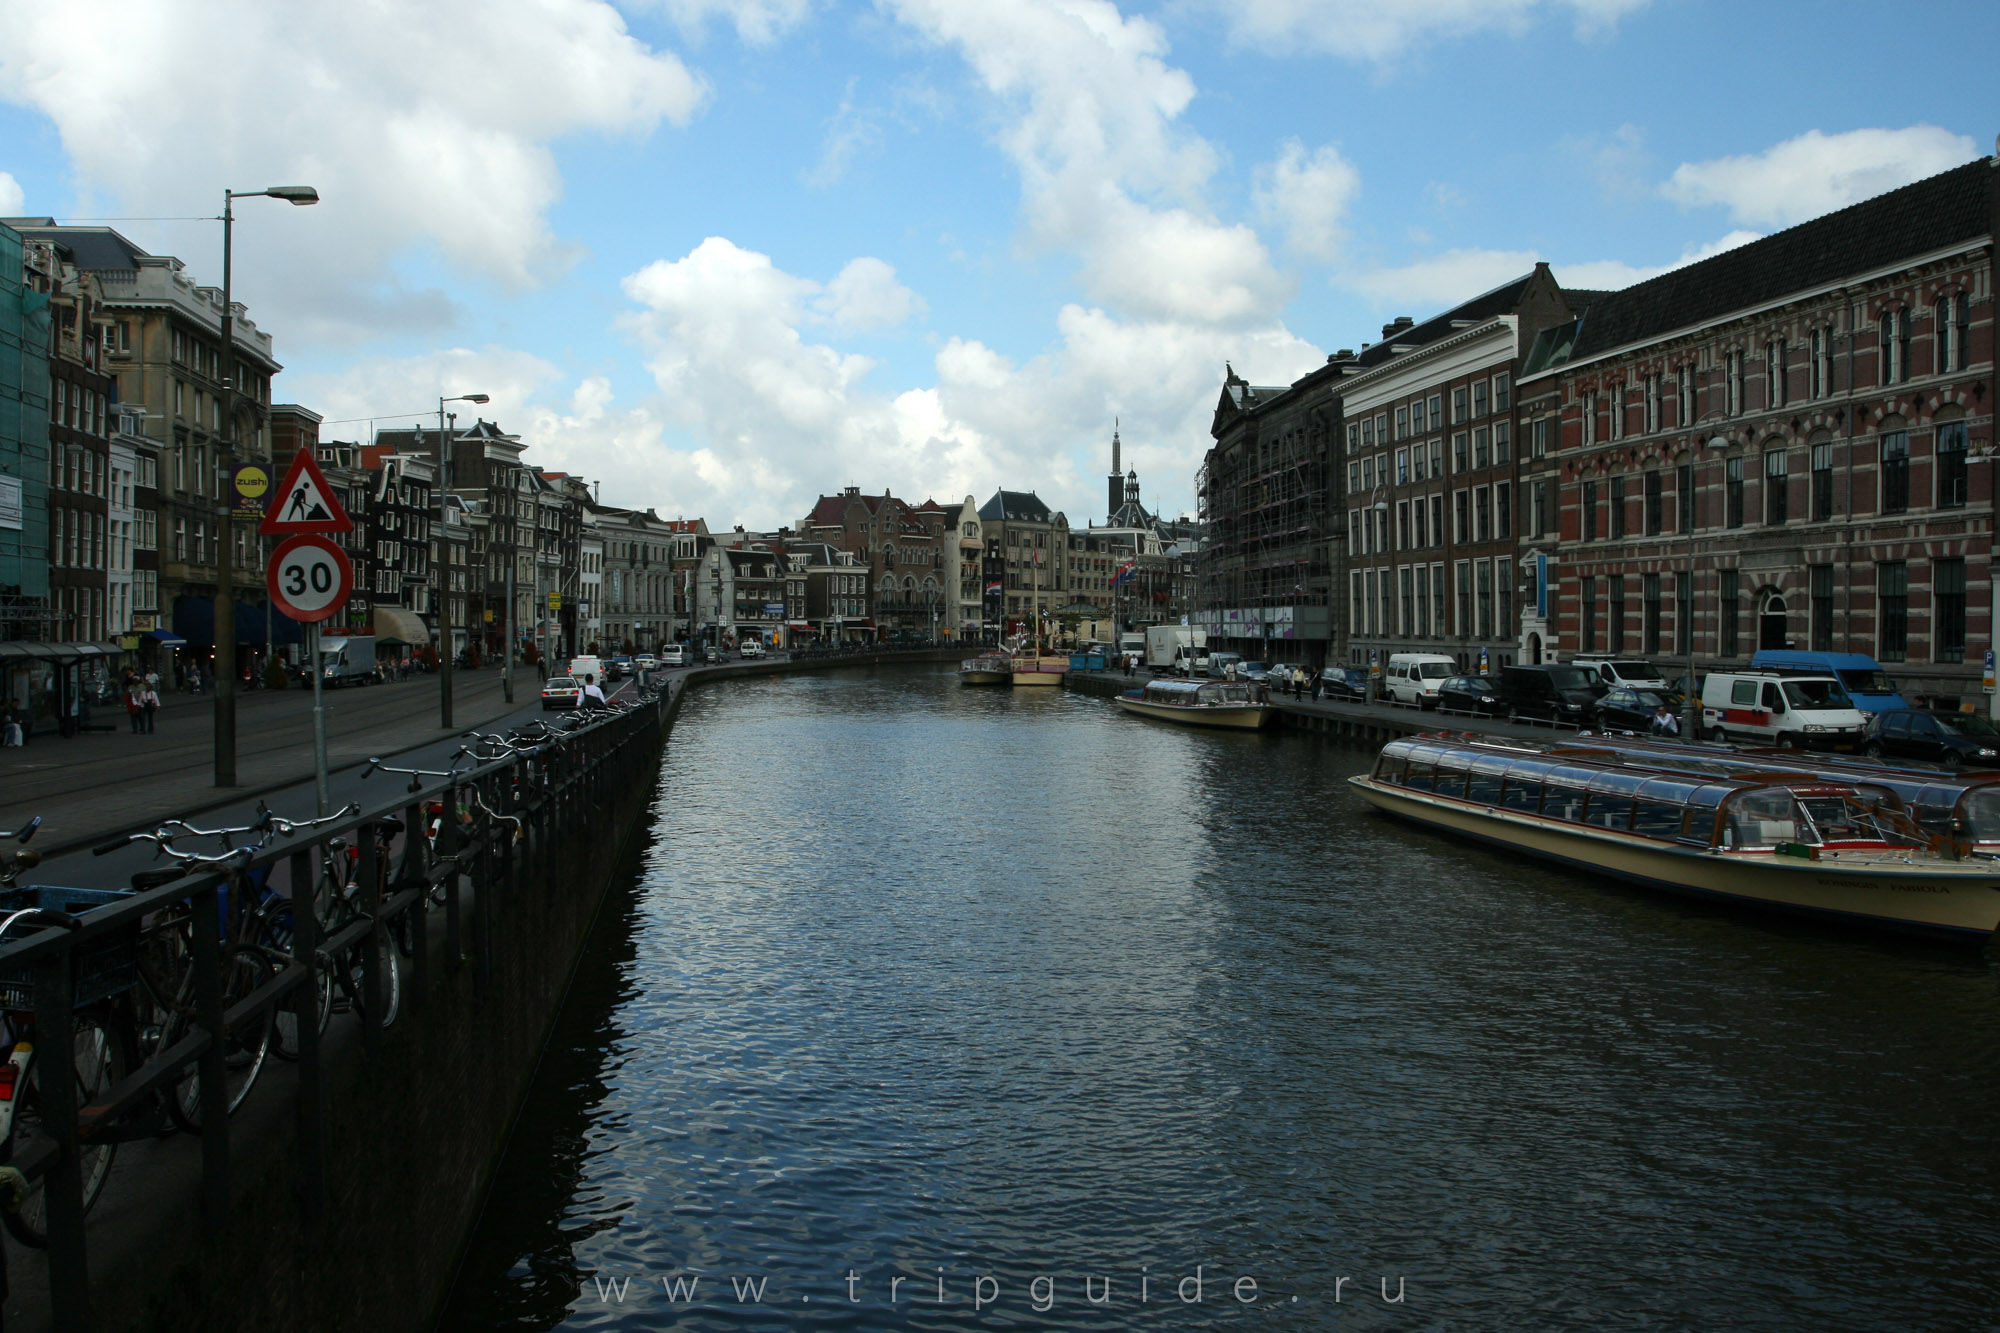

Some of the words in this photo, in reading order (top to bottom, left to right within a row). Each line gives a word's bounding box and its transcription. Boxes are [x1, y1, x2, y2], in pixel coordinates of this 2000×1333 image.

[236, 478, 267, 486] zushi
[285, 562, 332, 596] 30
[1986, 652, 1993, 663] P
